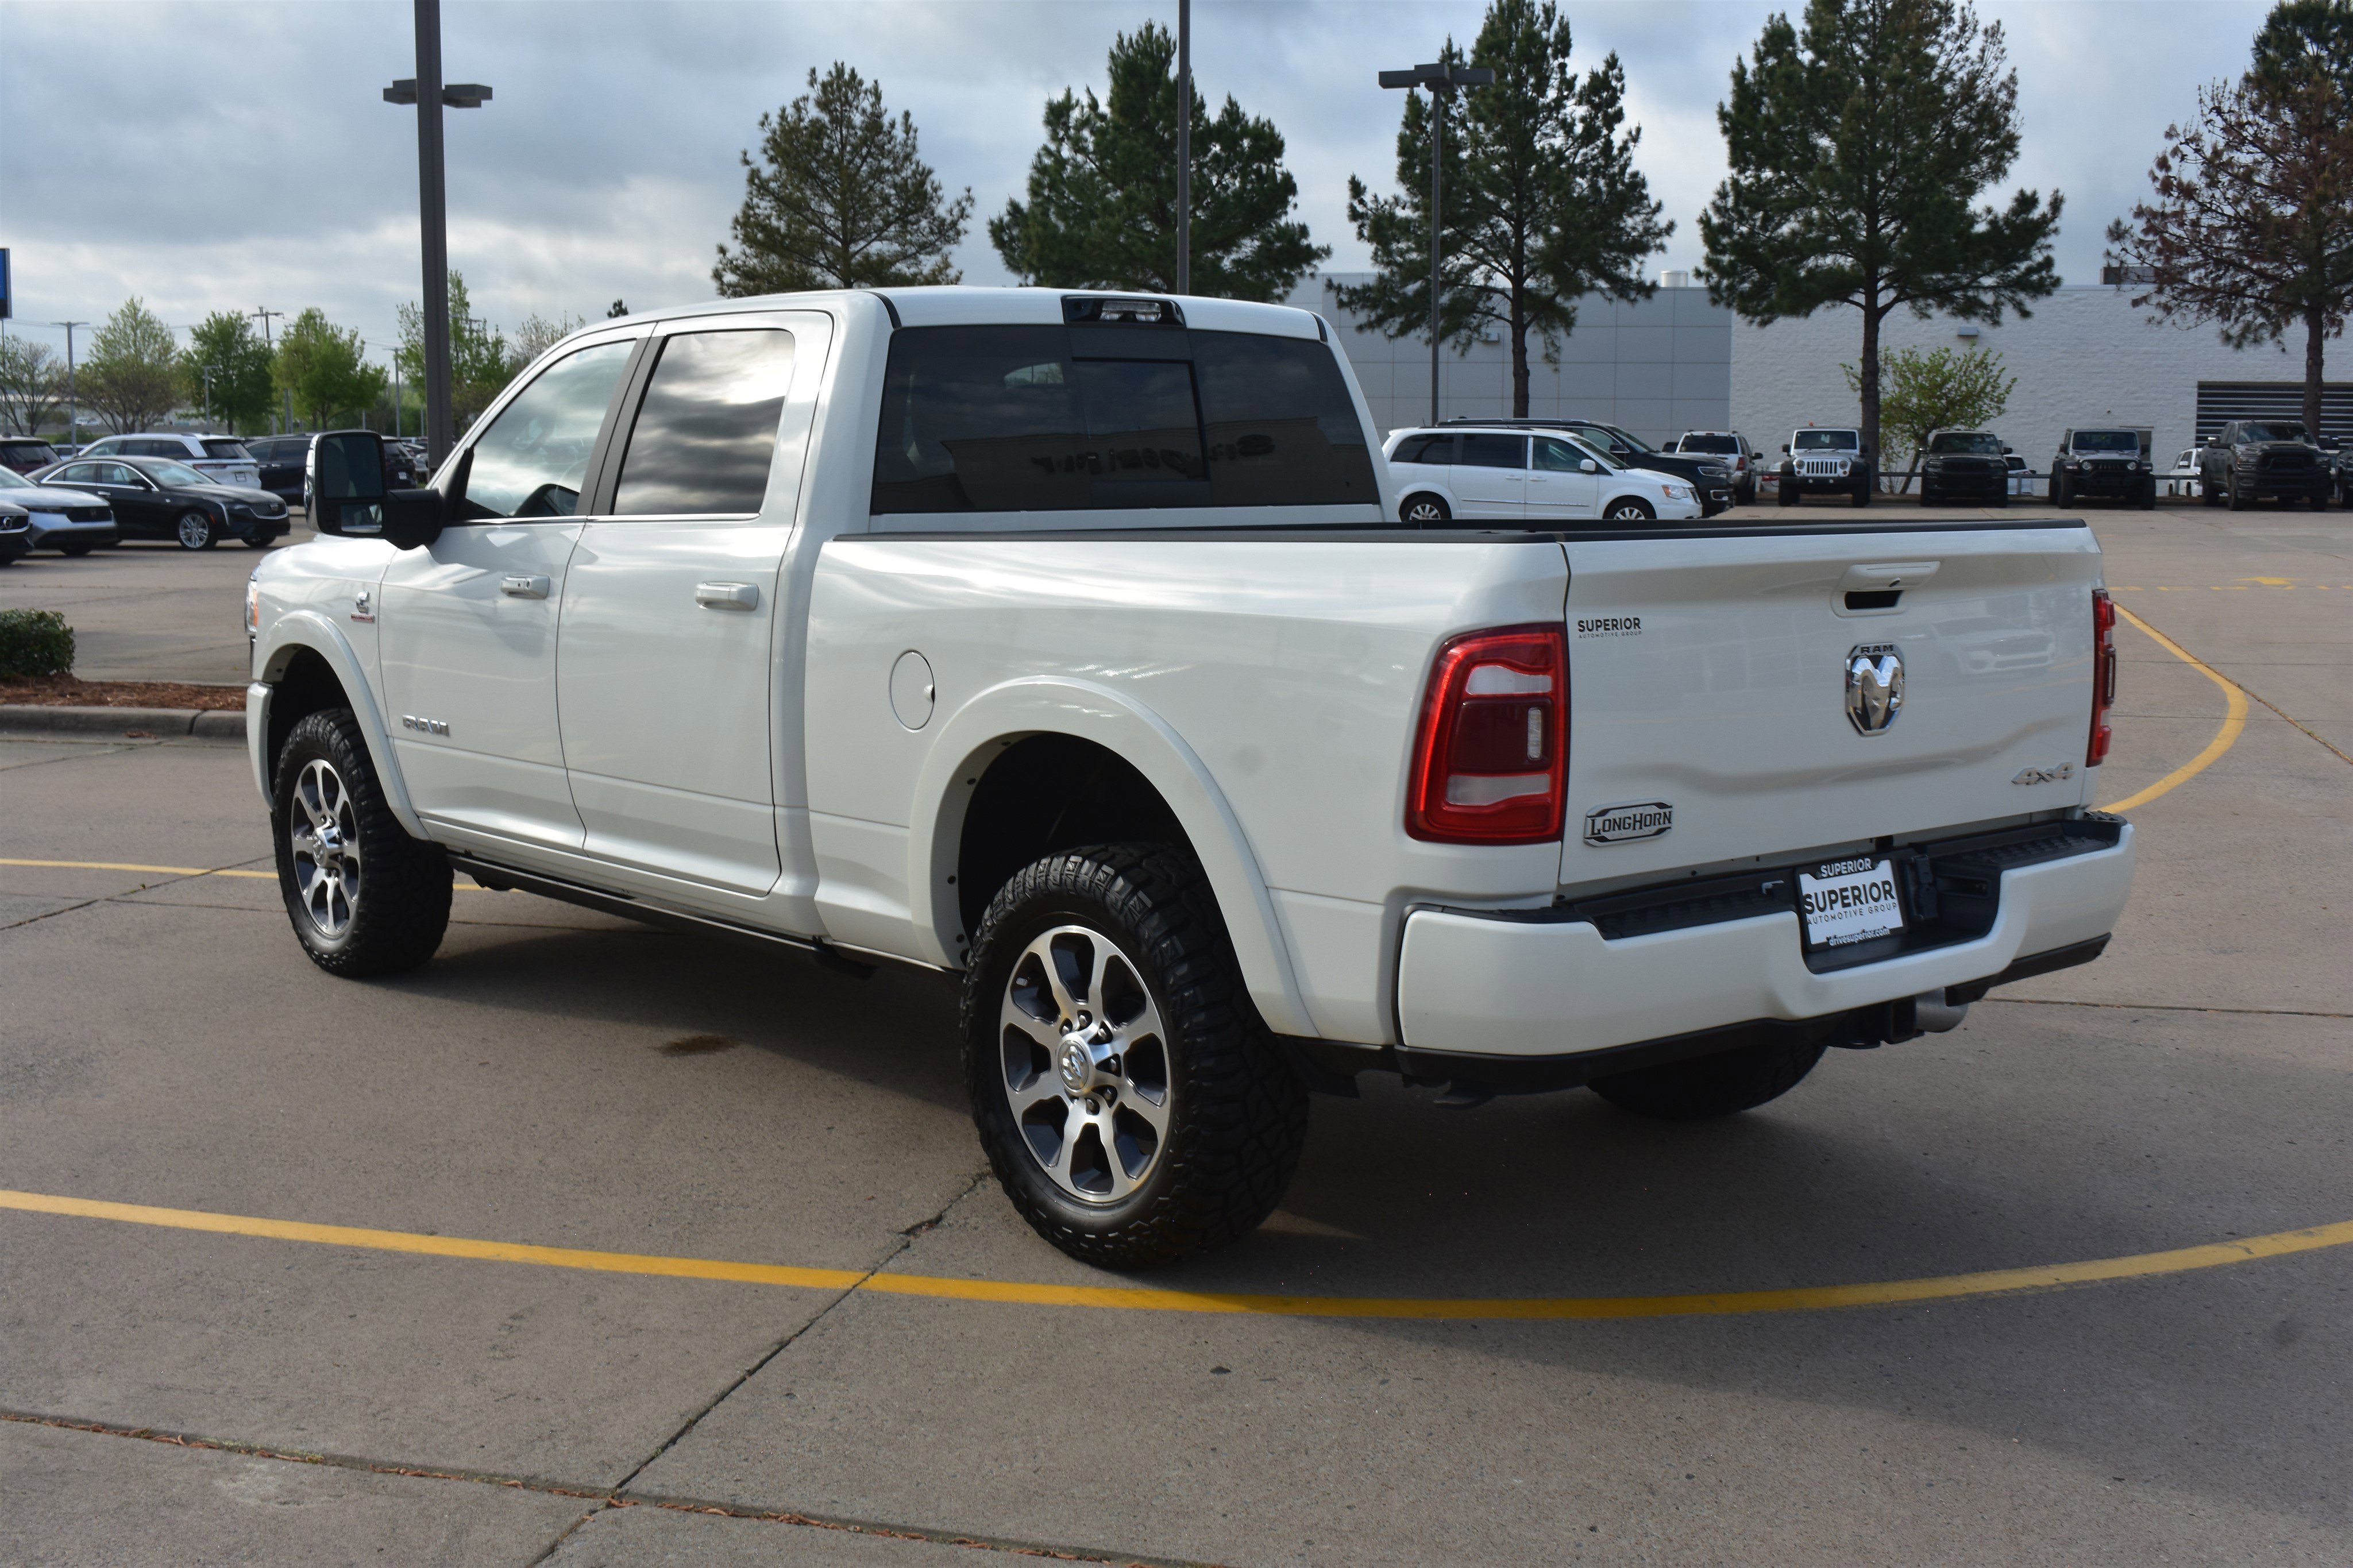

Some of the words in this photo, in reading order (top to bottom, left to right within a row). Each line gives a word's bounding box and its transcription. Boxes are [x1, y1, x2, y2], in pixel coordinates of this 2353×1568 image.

[1577, 617, 1641, 632] SUPERIOR
[1860, 645, 1894, 654] RAM
[402, 715, 450, 737] RAM
[1820, 858, 1872, 878] SUPERIOR
[1803, 880, 1896, 914] SUPERIOR
[1807, 908, 1864, 926] AUTOMOTIVE
[1868, 902, 1897, 914] GROUP
